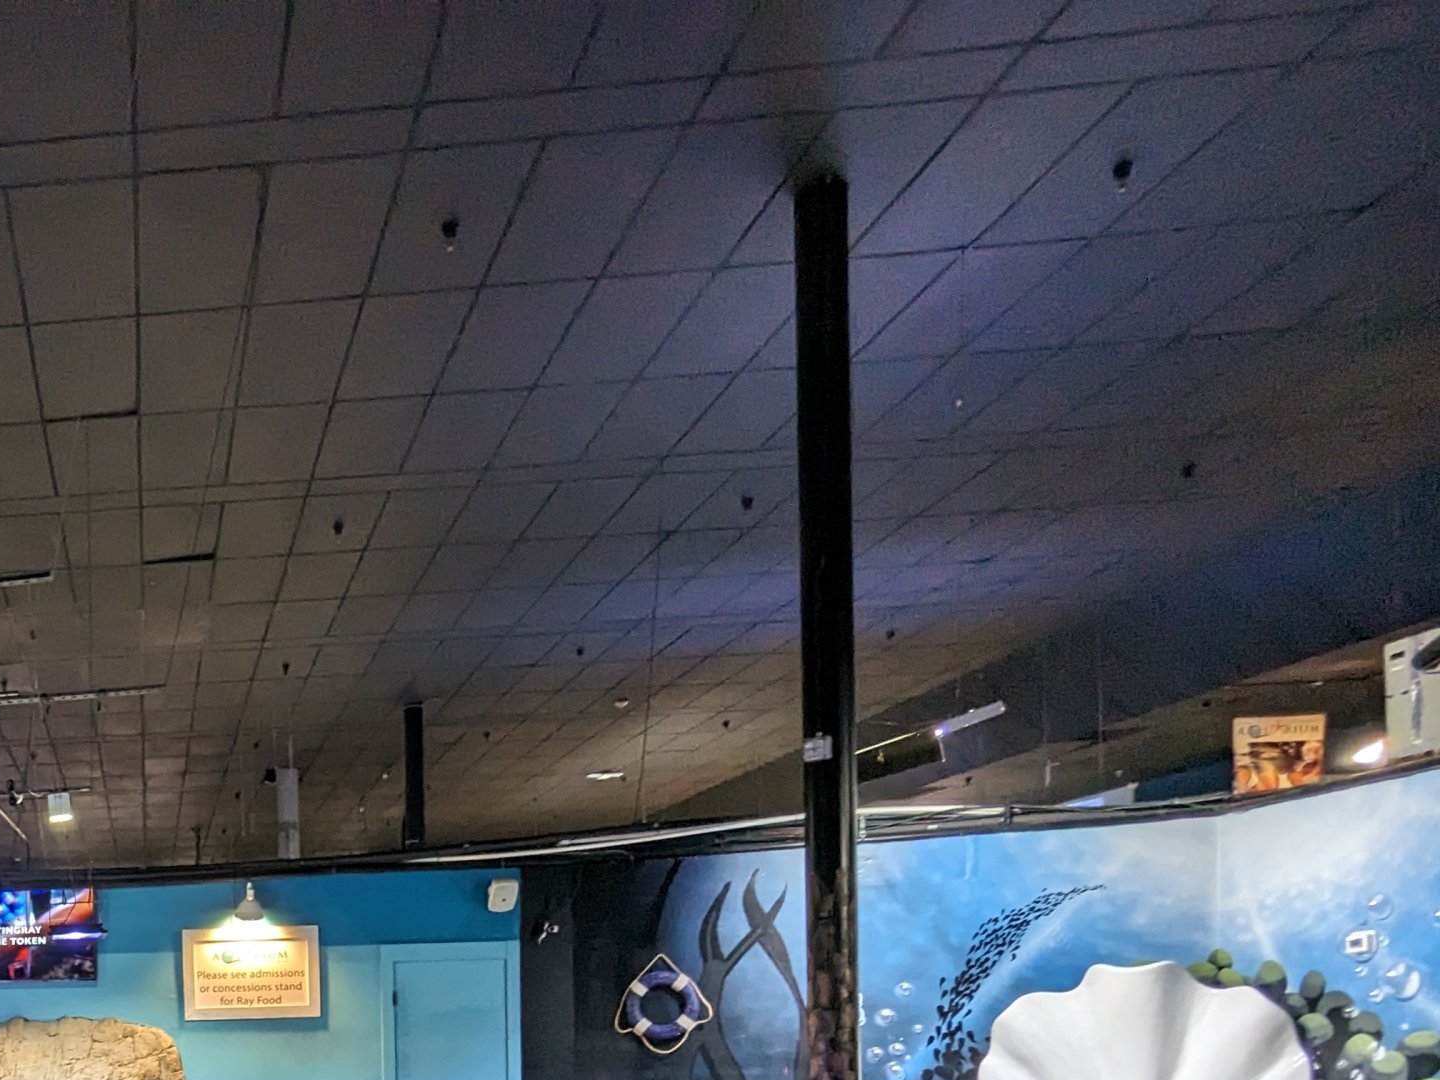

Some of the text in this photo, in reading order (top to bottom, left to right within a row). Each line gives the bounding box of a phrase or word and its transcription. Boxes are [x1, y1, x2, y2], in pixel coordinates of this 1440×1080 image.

[10, 936, 46, 946] TOKEN
[197, 969, 305, 980] Please see admissions
[213, 983, 272, 993] concessions
[275, 981, 302, 991] stand
[220, 995, 282, 1008] for Ray Food
